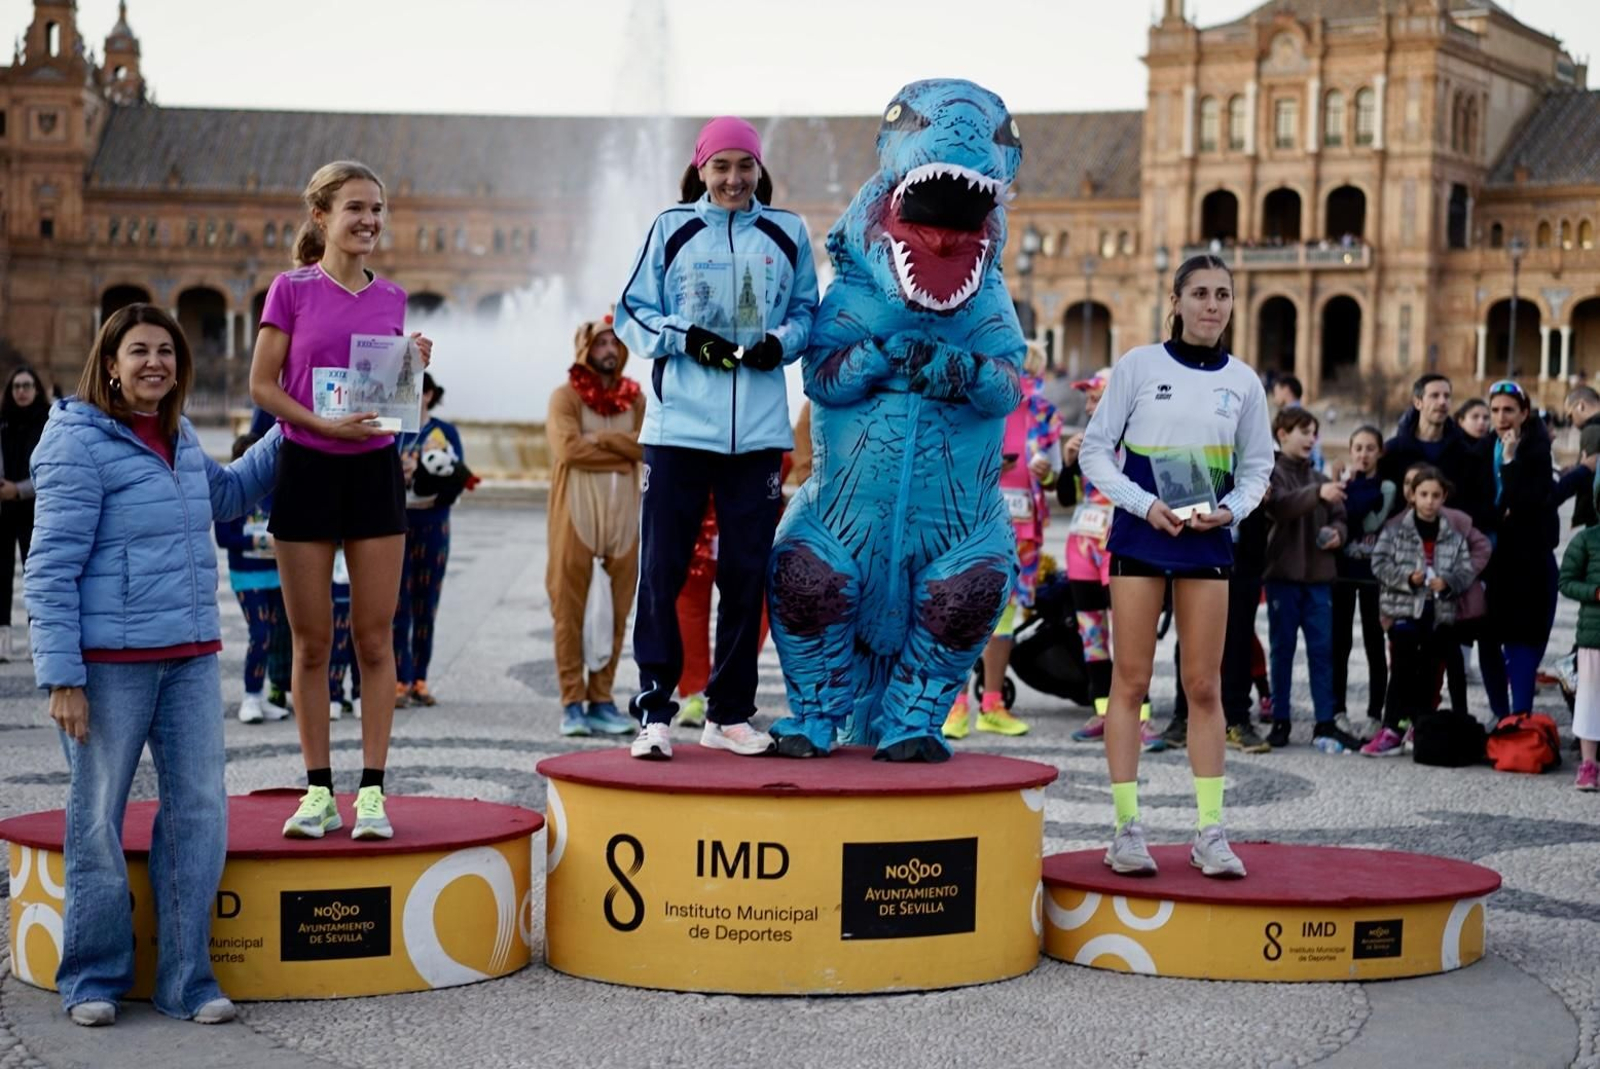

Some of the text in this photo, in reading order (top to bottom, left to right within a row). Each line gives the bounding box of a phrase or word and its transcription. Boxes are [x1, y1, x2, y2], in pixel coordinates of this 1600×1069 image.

[696, 839, 790, 880] IMD
[864, 885, 958, 901] AYUNTAMIENTO
[664, 901, 818, 924] Instituto Municipal
[879, 901, 944, 916] DE SEVILLA
[298, 921, 375, 933] AYUNTAMIENTO
[688, 924, 793, 944] de Deportes
[1302, 921, 1337, 938] IMD
[309, 932, 363, 944] DE SEVILLA
[210, 952, 245, 963] ortes
